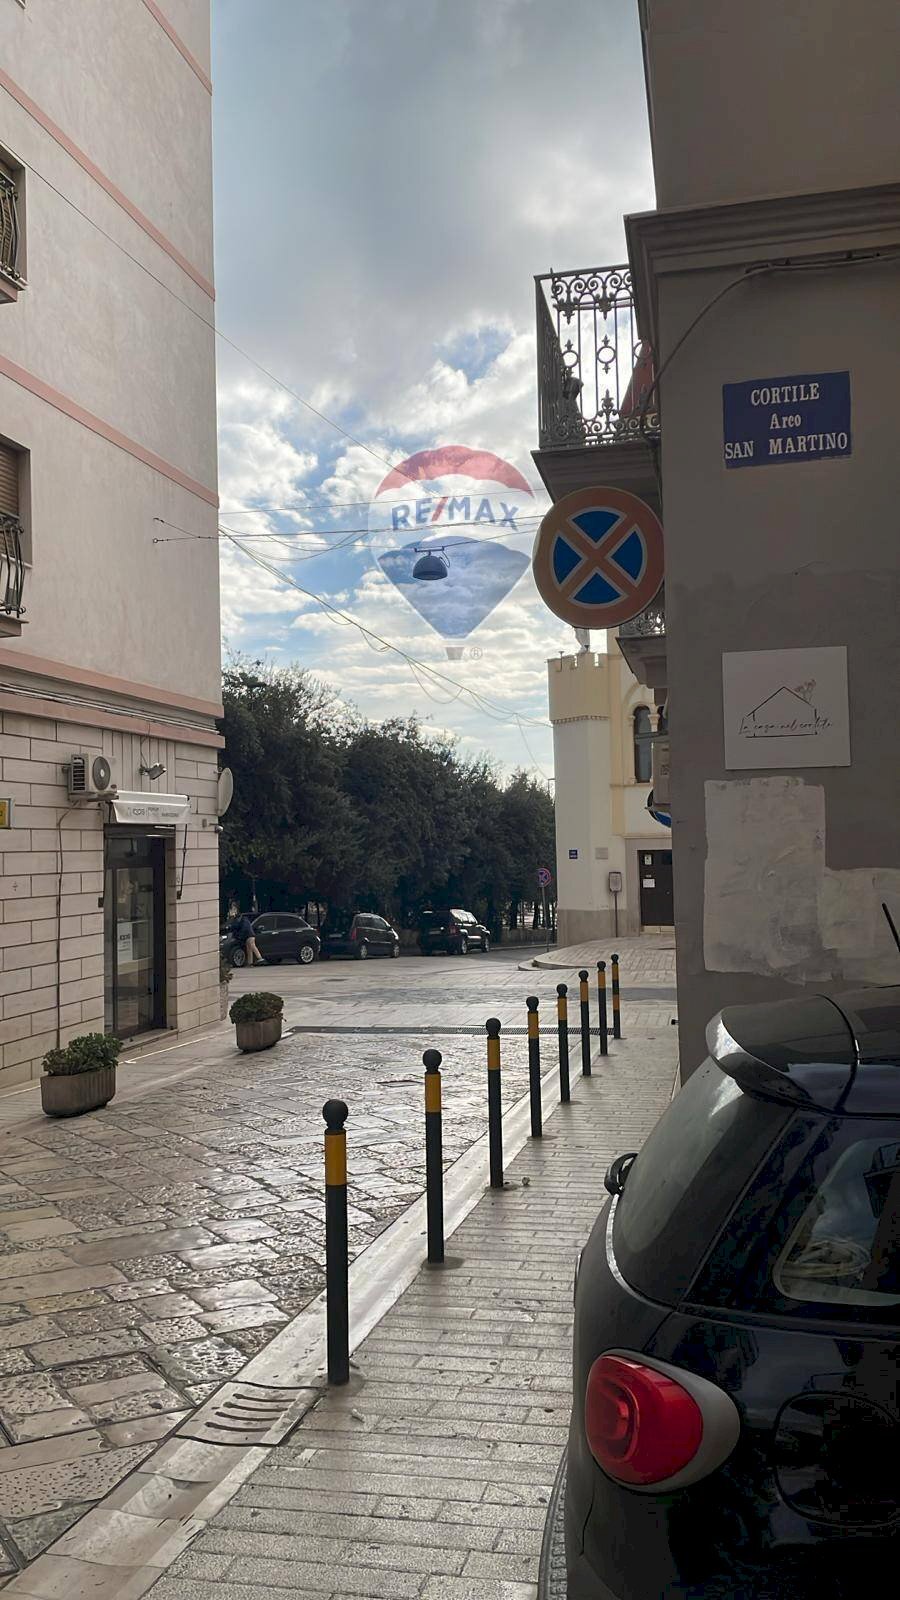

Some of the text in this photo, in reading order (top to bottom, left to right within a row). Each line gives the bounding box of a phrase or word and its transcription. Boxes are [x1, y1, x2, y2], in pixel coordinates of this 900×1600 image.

[751, 383, 820, 406] CORTILE
[769, 413, 802, 430] Arco
[725, 432, 848, 460] SAN MARTINO
